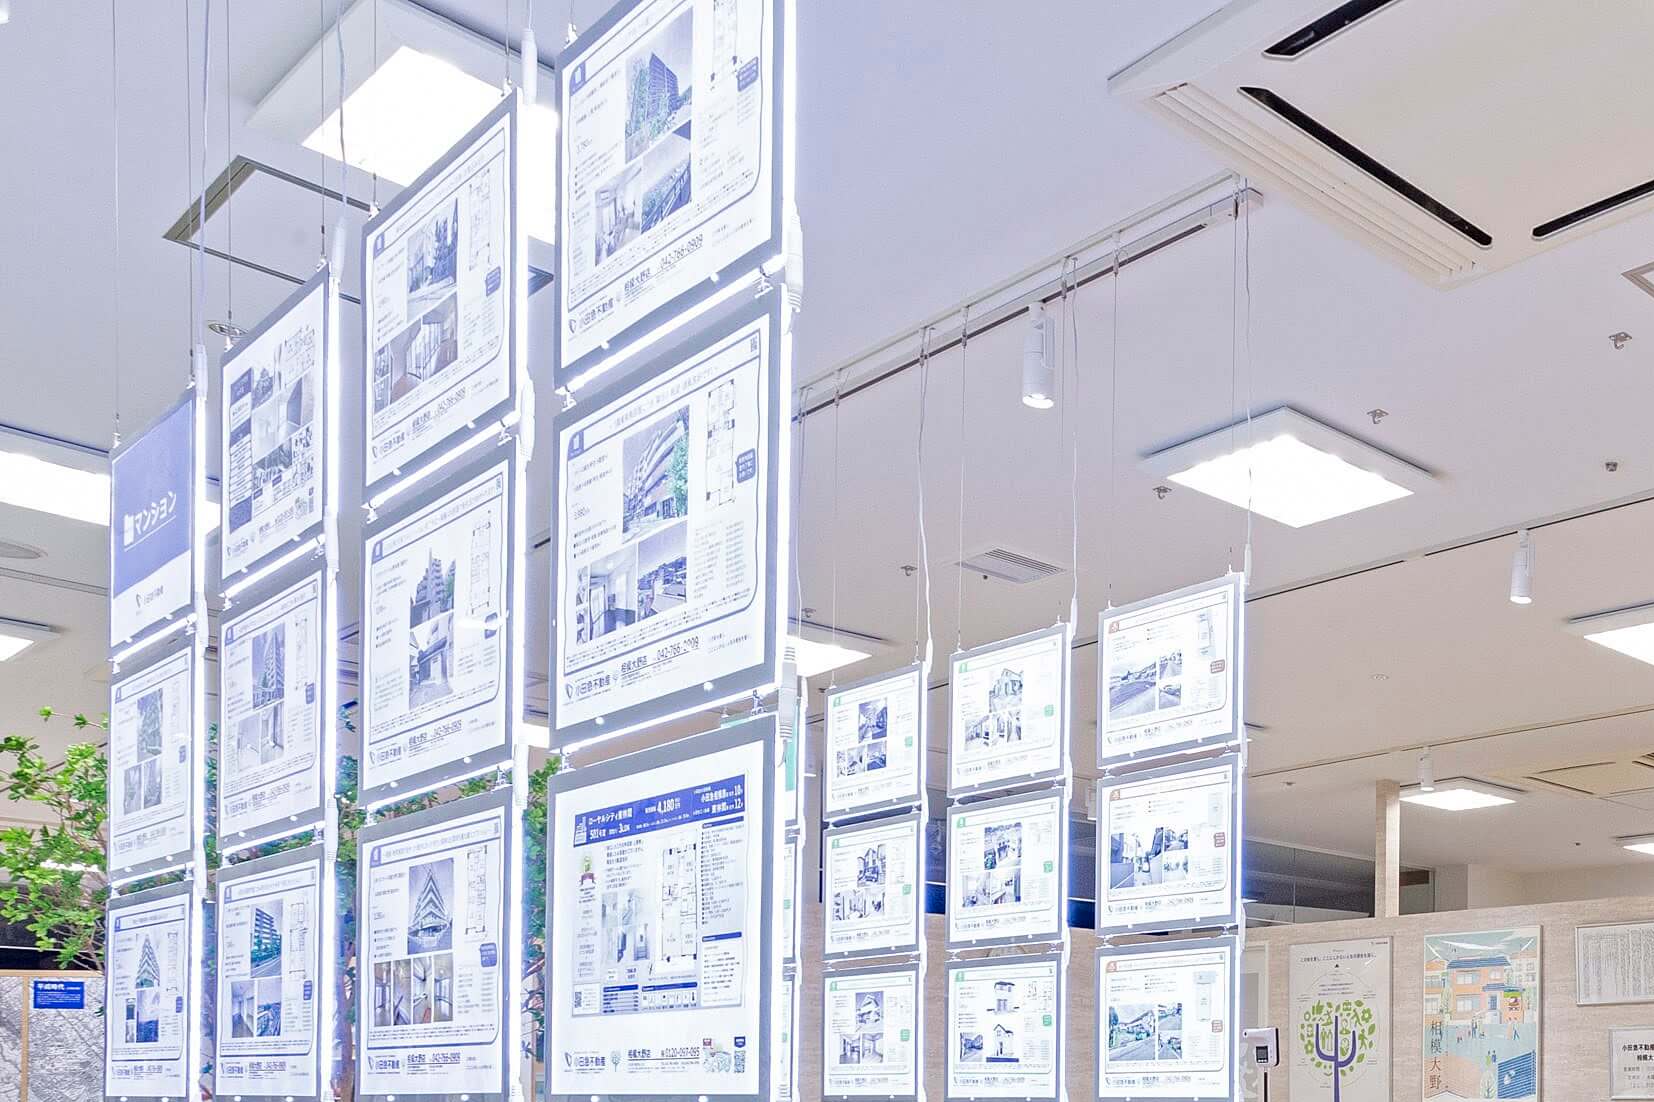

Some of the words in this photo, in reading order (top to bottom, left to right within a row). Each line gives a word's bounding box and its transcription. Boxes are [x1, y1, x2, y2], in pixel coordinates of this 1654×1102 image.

[134, 491, 177, 536] マンション
[1429, 1021, 1442, 1090] 相模大野
